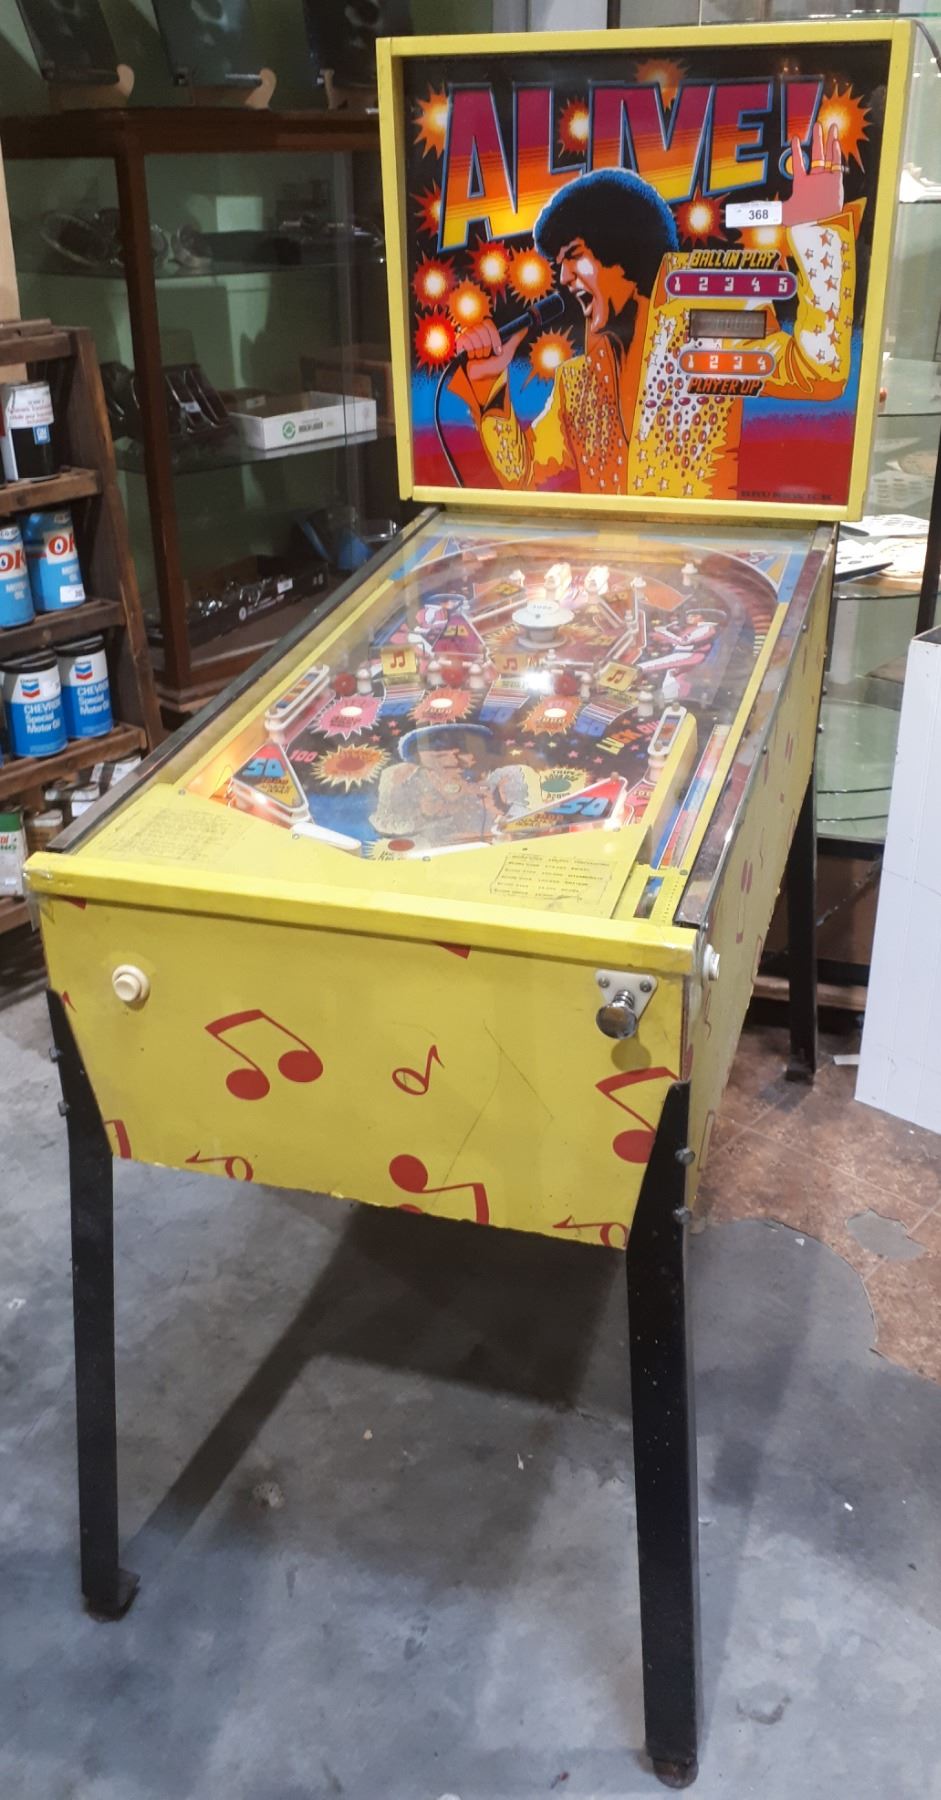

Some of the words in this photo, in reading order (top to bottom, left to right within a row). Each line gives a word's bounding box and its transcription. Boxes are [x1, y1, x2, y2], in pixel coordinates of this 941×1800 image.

[438, 76, 824, 253] ALIVE!
[748, 209, 769, 220] 368
[691, 251, 721, 268] BALL
[722, 251, 740, 268] IN
[740, 251, 778, 268] PLAY
[674, 277, 681, 291] 1
[699, 277, 709, 291] 2
[724, 277, 734, 292] 3
[751, 277, 760, 292] 4
[778, 278, 788, 292] 5
[688, 355, 694, 369] 1
[709, 355, 719, 369] 2
[733, 356, 743, 370] 3
[757, 356, 766, 371] 4
[688, 377, 740, 394] PLAYER
[740, 379, 761, 396] UP
[27, 722, 52, 734] Motor
[290, 750, 318, 763] 100
[242, 757, 286, 778] 50
[550, 795, 609, 816] 50
